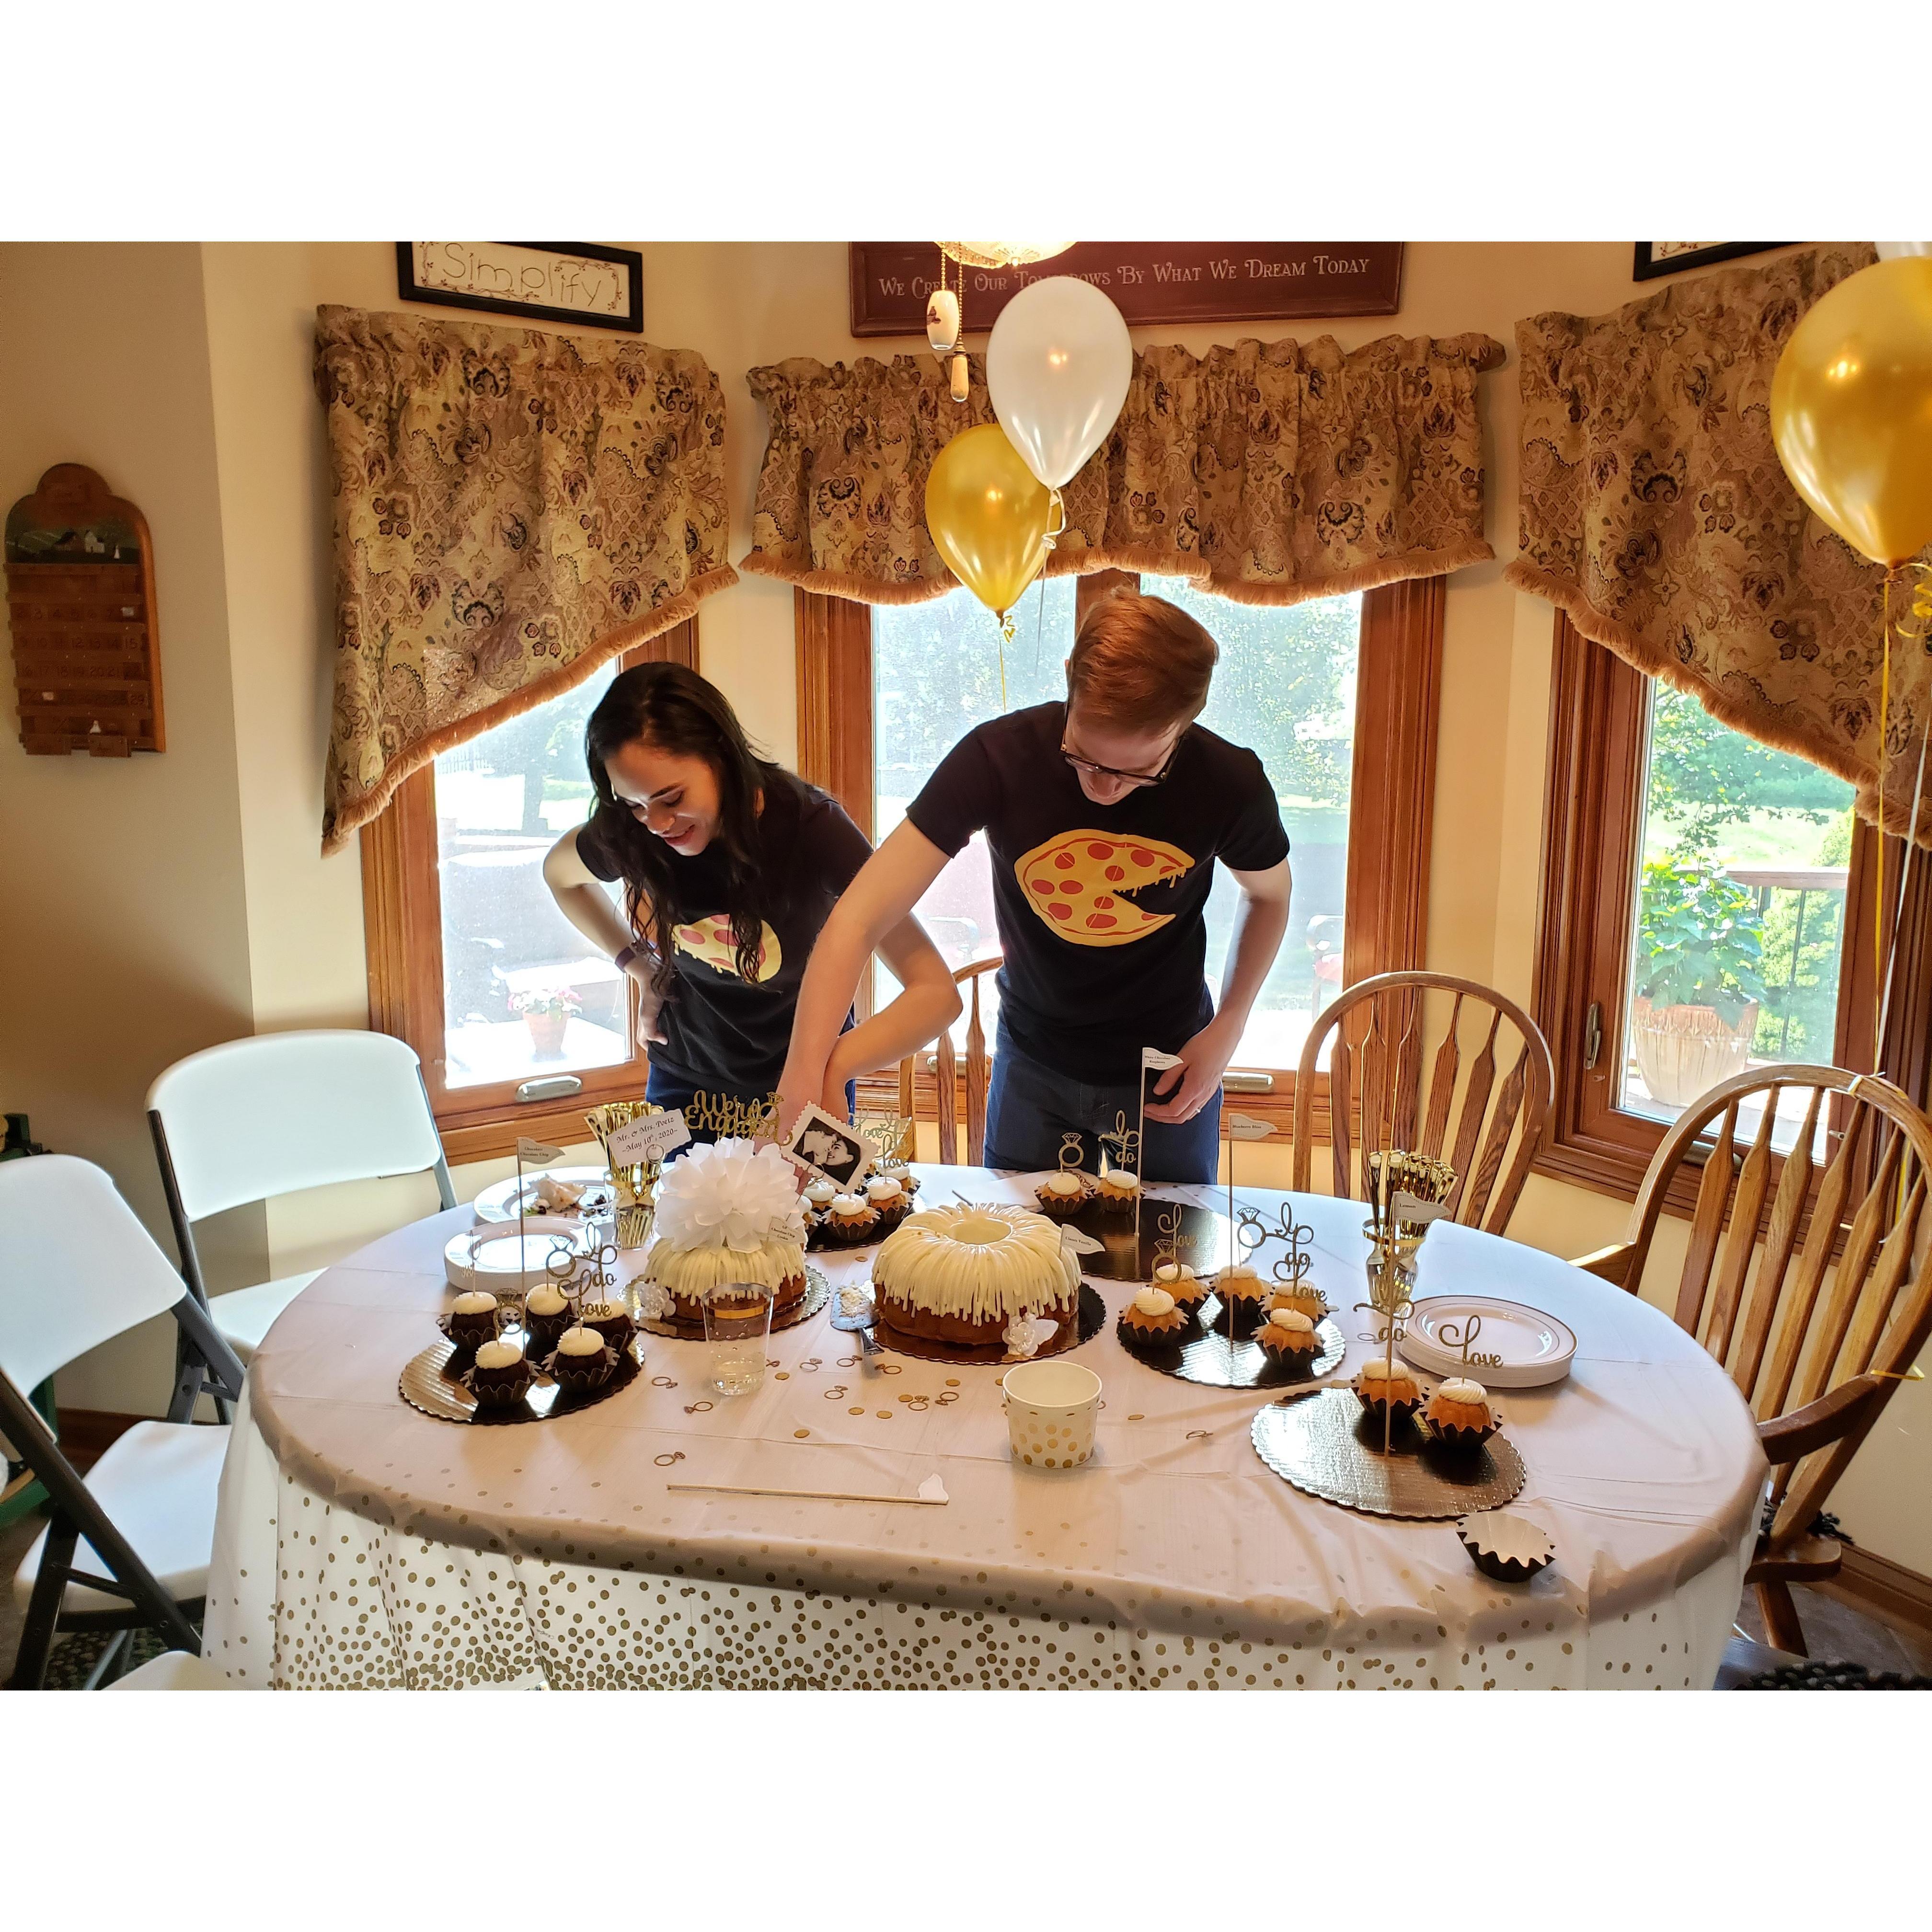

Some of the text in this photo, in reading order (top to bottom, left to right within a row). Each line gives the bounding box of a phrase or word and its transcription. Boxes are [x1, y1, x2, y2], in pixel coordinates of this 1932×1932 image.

[443, 243, 602, 307] Simplify
[639, 1125, 655, 1134] Mrs.
[656, 1117, 675, 1127] Poetz
